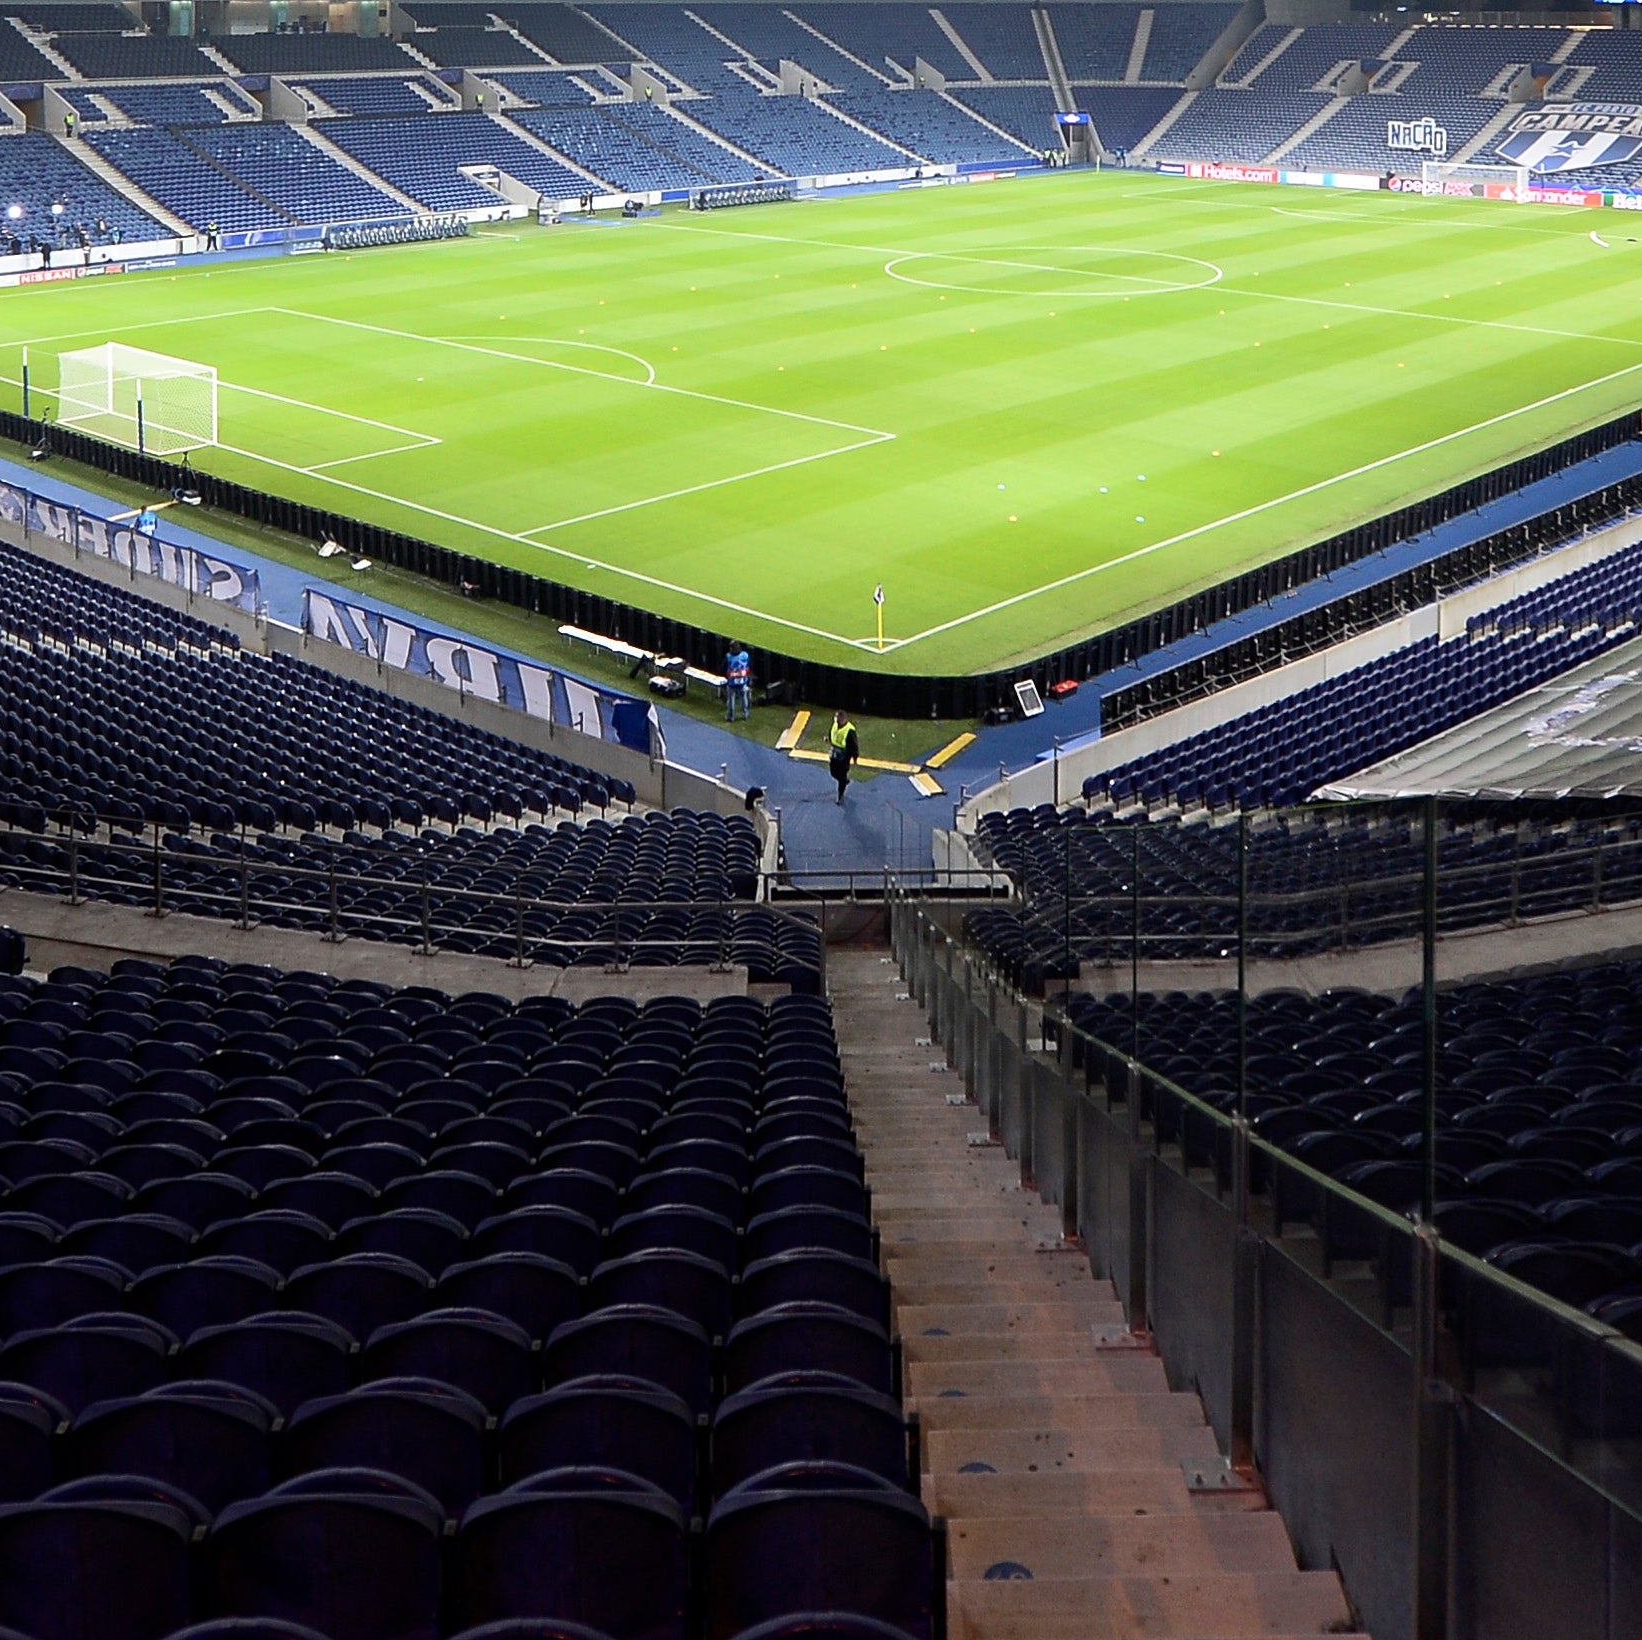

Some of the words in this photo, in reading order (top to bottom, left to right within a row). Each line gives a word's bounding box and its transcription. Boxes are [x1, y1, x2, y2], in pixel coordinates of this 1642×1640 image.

[1207, 164, 1273, 182] Hotels.com
[1402, 179, 1443, 195] pepsi
[1515, 187, 1586, 206] Santander
[20, 269, 72, 285] NISSAN
